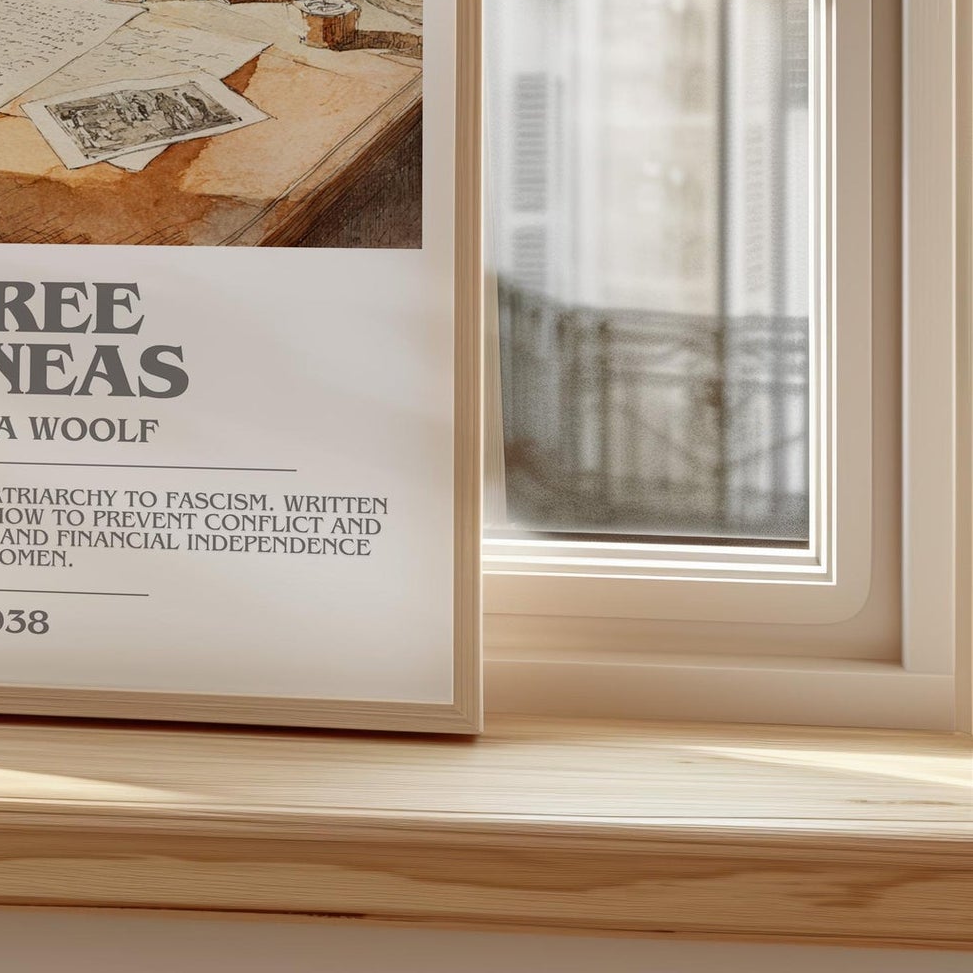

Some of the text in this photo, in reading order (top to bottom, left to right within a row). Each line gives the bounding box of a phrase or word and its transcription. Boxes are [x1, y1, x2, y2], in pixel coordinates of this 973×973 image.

[27, 416, 160, 444] WOOLF
[123, 490, 158, 509] TO
[165, 491, 275, 512] FASCISM.
[282, 494, 388, 515] WRITTEN
[50, 508, 86, 527] TO
[92, 509, 199, 530] PREVENT
[203, 512, 325, 534] CONFLICT
[330, 516, 382, 536] AND
[56, 529, 181, 551] FINANCIAL
[186, 533, 372, 557] INDEPENDENCE
